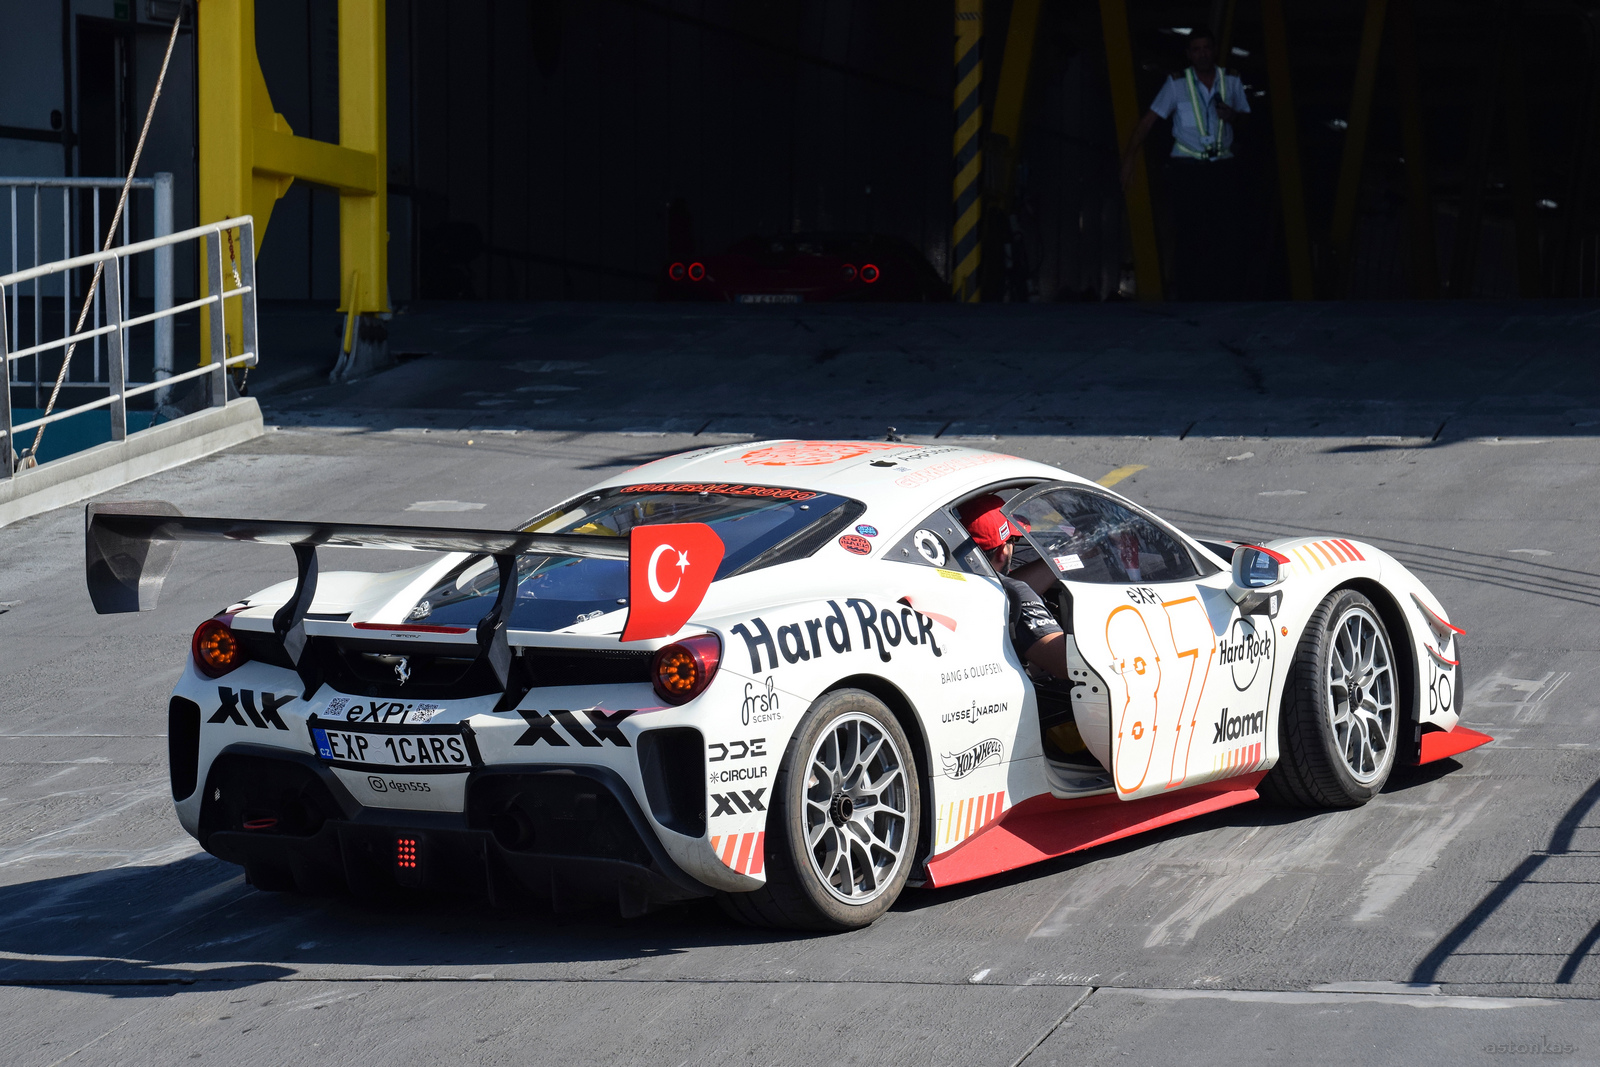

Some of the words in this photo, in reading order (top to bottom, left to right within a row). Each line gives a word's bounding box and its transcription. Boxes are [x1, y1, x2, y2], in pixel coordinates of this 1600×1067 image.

[730, 598, 851, 675] Hard
[847, 597, 943, 663] Rock
[1219, 635, 1245, 666] Hard
[1246, 630, 1271, 664] Rock
[941, 669, 962, 684] BANG
[964, 668, 969, 679] &
[970, 662, 1003, 679] OLUFSEN
[346, 701, 413, 724] eXPi
[752, 713, 782, 724] SCENTS
[941, 708, 971, 723] ULYSSE
[976, 702, 1008, 717] NARDIN
[319, 747, 332, 757] CZ
[326, 732, 369, 761] EXP
[384, 737, 465, 764] 1CARS
[719, 766, 768, 783] CIRCULR
[389, 780, 431, 792] dgn555
